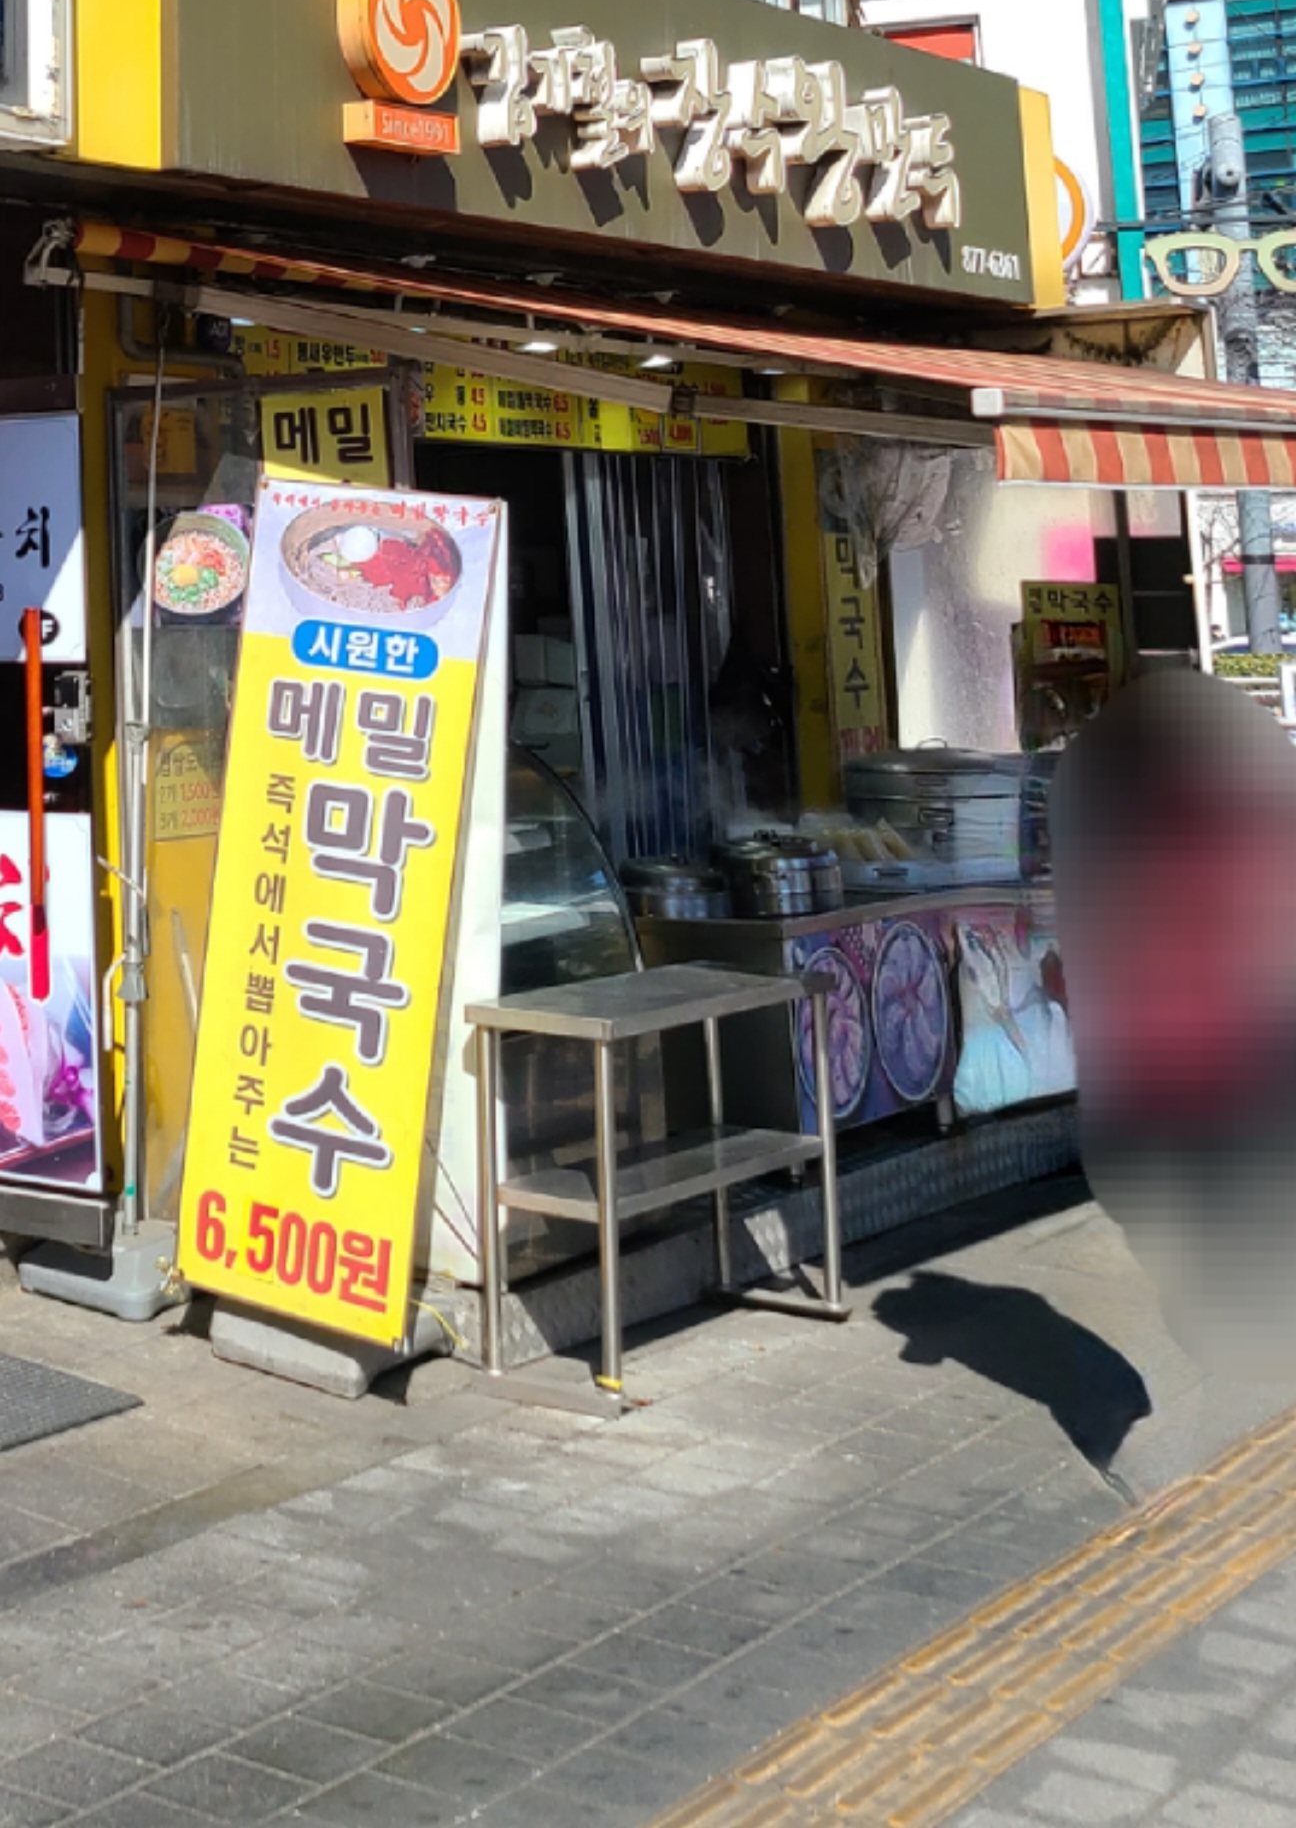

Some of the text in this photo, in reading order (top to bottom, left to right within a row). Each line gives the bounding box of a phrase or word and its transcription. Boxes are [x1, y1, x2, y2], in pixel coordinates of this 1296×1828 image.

[273, 402, 374, 466] 메밀
[308, 624, 420, 673] 시원한
[266, 679, 439, 780] 메밀
[268, 780, 437, 1198] 막국수
[194, 1188, 394, 1313] 6,500원
